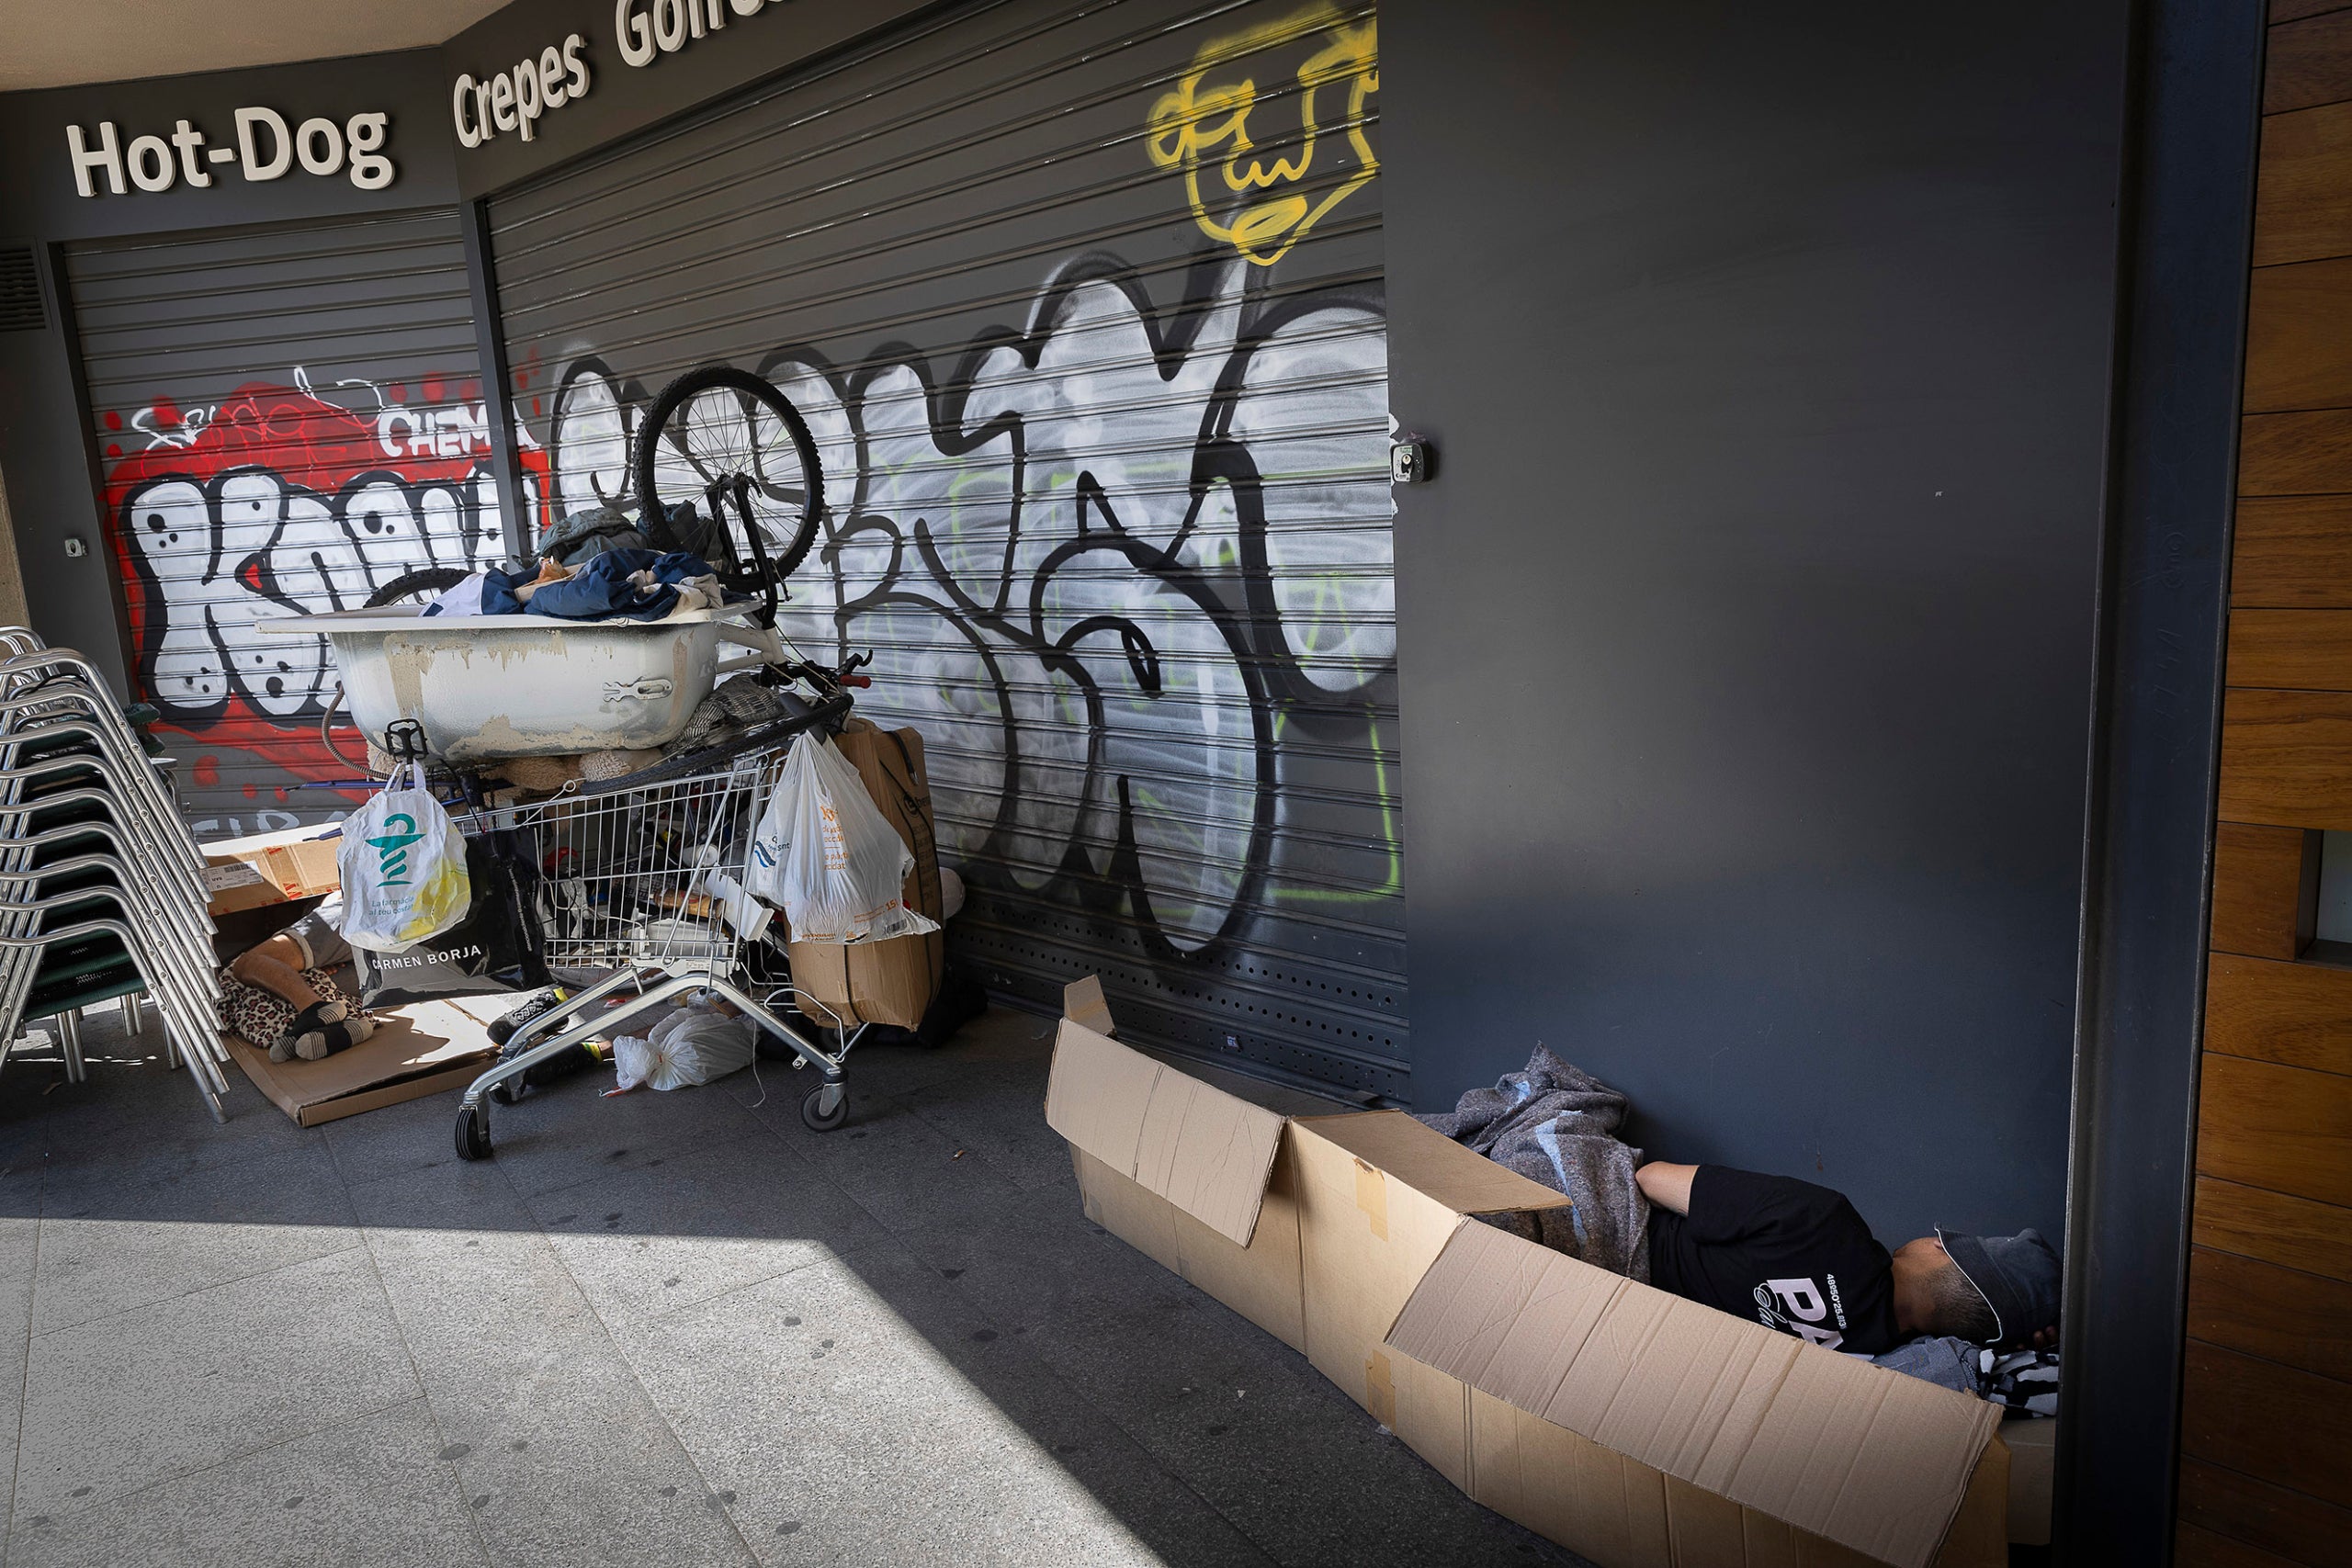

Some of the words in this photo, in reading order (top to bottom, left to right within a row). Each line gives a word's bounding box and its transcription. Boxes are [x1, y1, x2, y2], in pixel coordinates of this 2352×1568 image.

[453, 33, 590, 148] Crepes
[66, 106, 396, 197] Hot-Dog
[372, 955, 423, 970] CARMEN
[427, 944, 481, 965] BORJA
